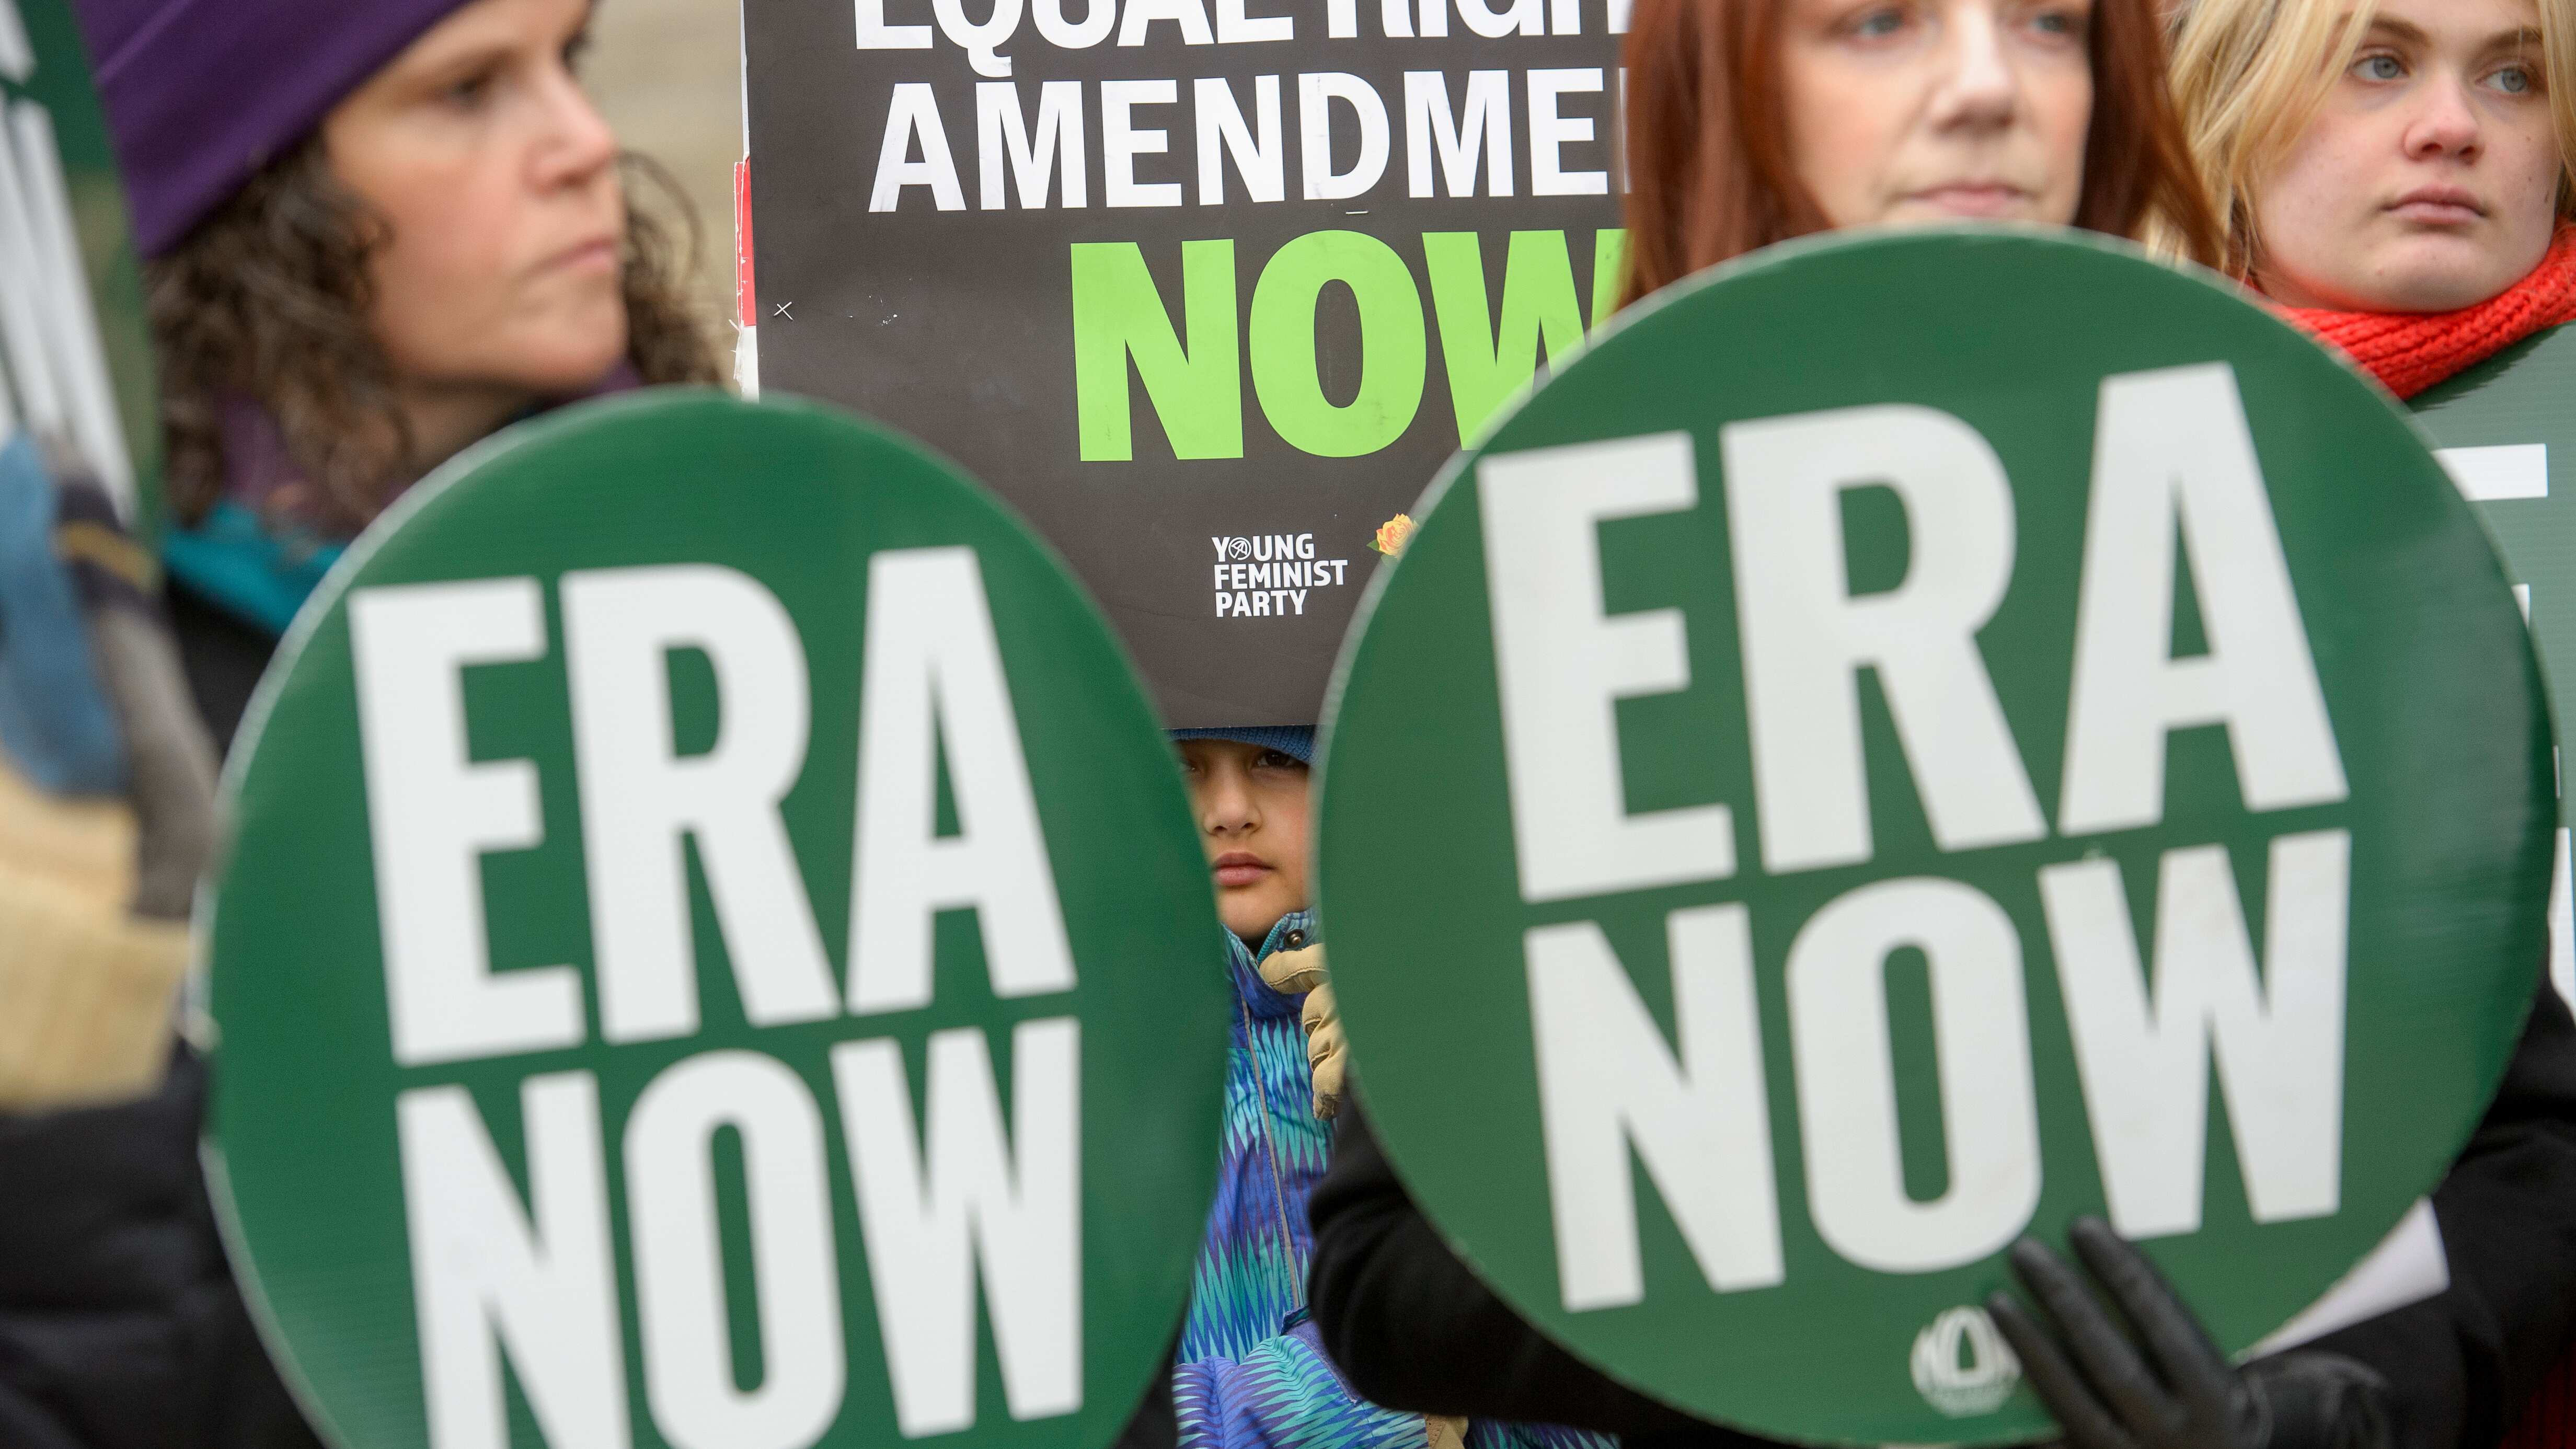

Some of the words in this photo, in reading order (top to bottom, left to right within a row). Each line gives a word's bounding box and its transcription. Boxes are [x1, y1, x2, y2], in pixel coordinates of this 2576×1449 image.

[868, 68, 1629, 213] AMENDME
[1070, 228, 1632, 462] NOW
[1214, 559, 1348, 590] FEMINIST
[1215, 589, 1307, 617] PARTY
[1476, 361, 2349, 903] ERA
[347, 545, 1078, 1067] ERA
[396, 1016, 1081, 1449] NOW
[1523, 829, 2350, 1312] NOW
